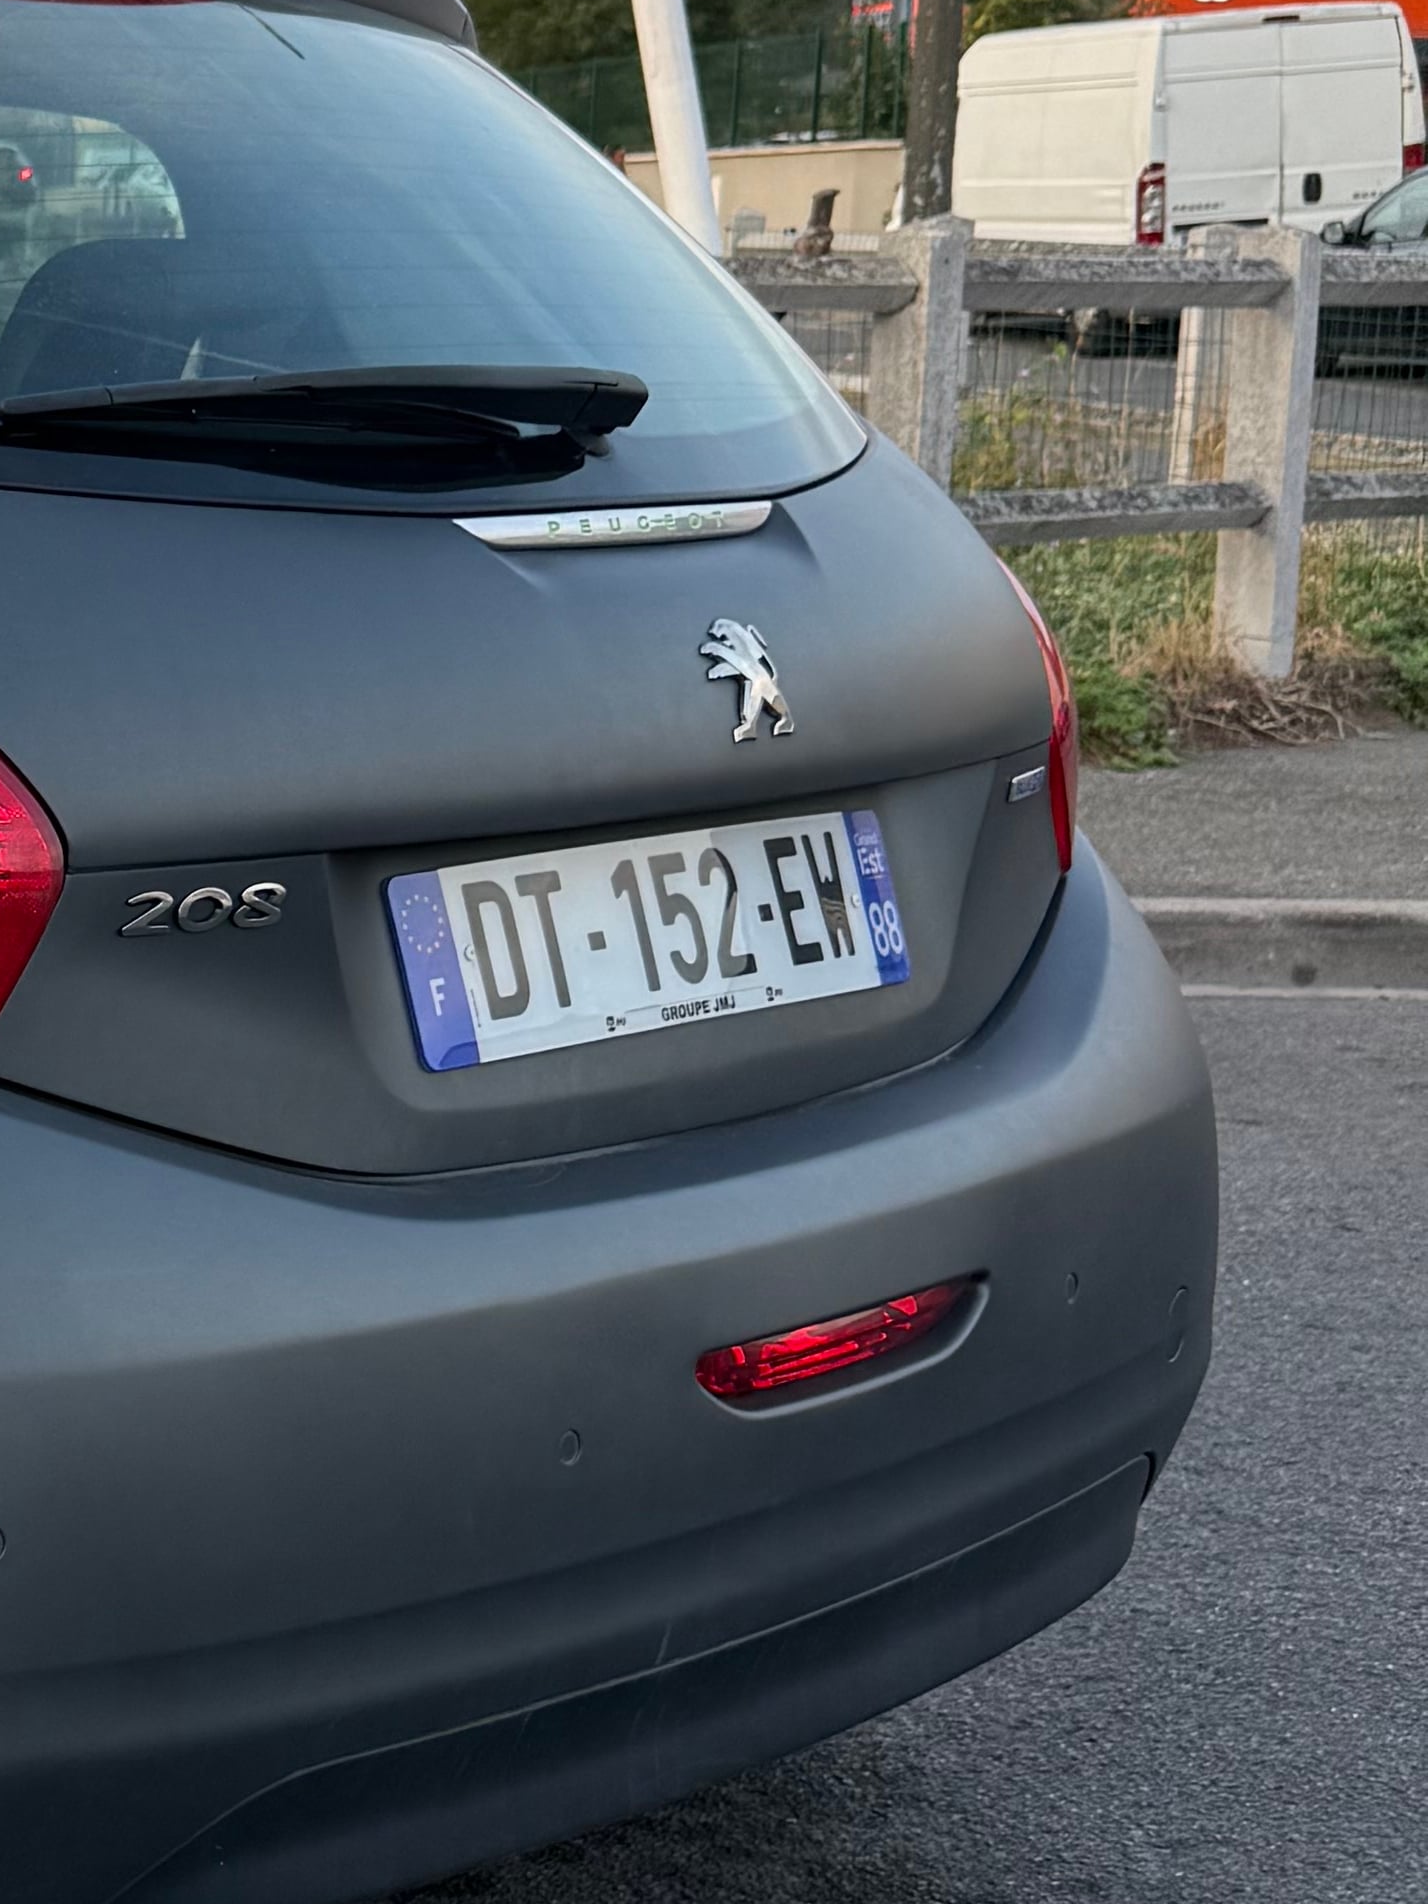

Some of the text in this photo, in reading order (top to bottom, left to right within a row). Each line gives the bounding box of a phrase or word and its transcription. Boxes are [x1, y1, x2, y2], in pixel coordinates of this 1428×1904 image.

[547, 510, 724, 537] PEUGEOT
[857, 848, 885, 876] Est
[121, 882, 287, 937] 208
[461, 831, 856, 1021] DT-152-EW
[868, 900, 903, 957] 88
[429, 977, 445, 1016] F
[661, 995, 736, 1022] GROUPE JMJ
